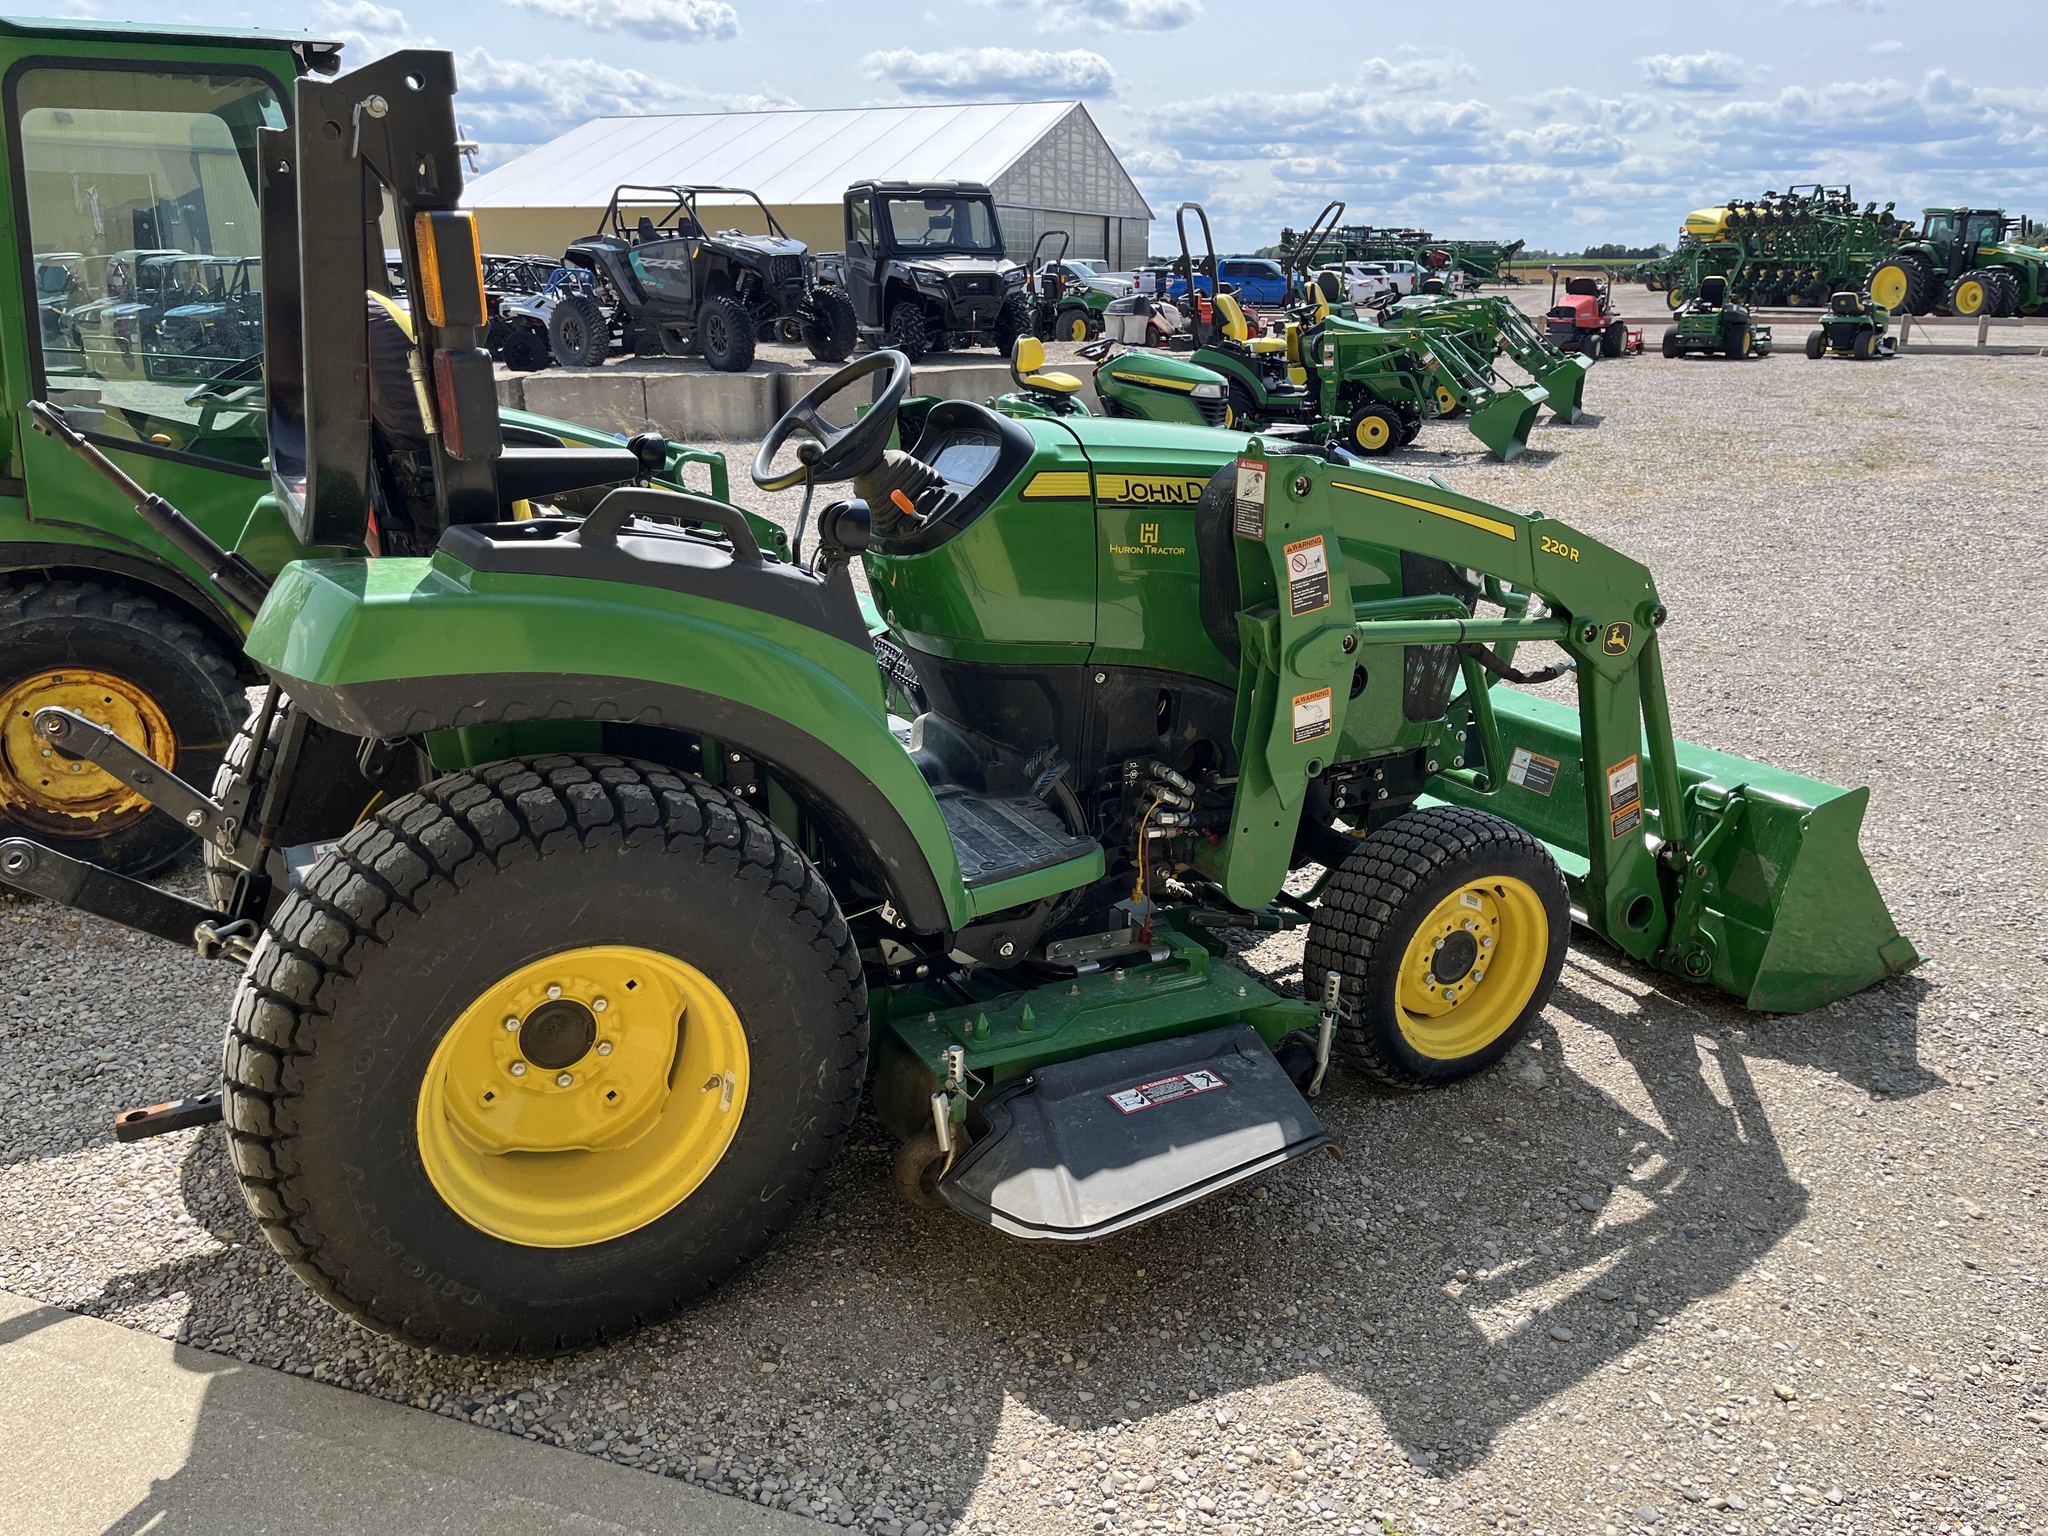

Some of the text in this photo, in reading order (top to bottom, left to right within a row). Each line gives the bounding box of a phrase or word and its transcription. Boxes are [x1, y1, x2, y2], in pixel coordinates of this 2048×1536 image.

[634, 257, 684, 270] RZR
[1246, 462, 1264, 470] DANGER
[1117, 479, 1204, 503] JOHN D
[1109, 544, 1186, 555] HURON TRACTOR
[1291, 537, 1322, 551] WARNING
[1300, 689, 1330, 702] WARNING
[1149, 1077, 1178, 1088] DANGER
